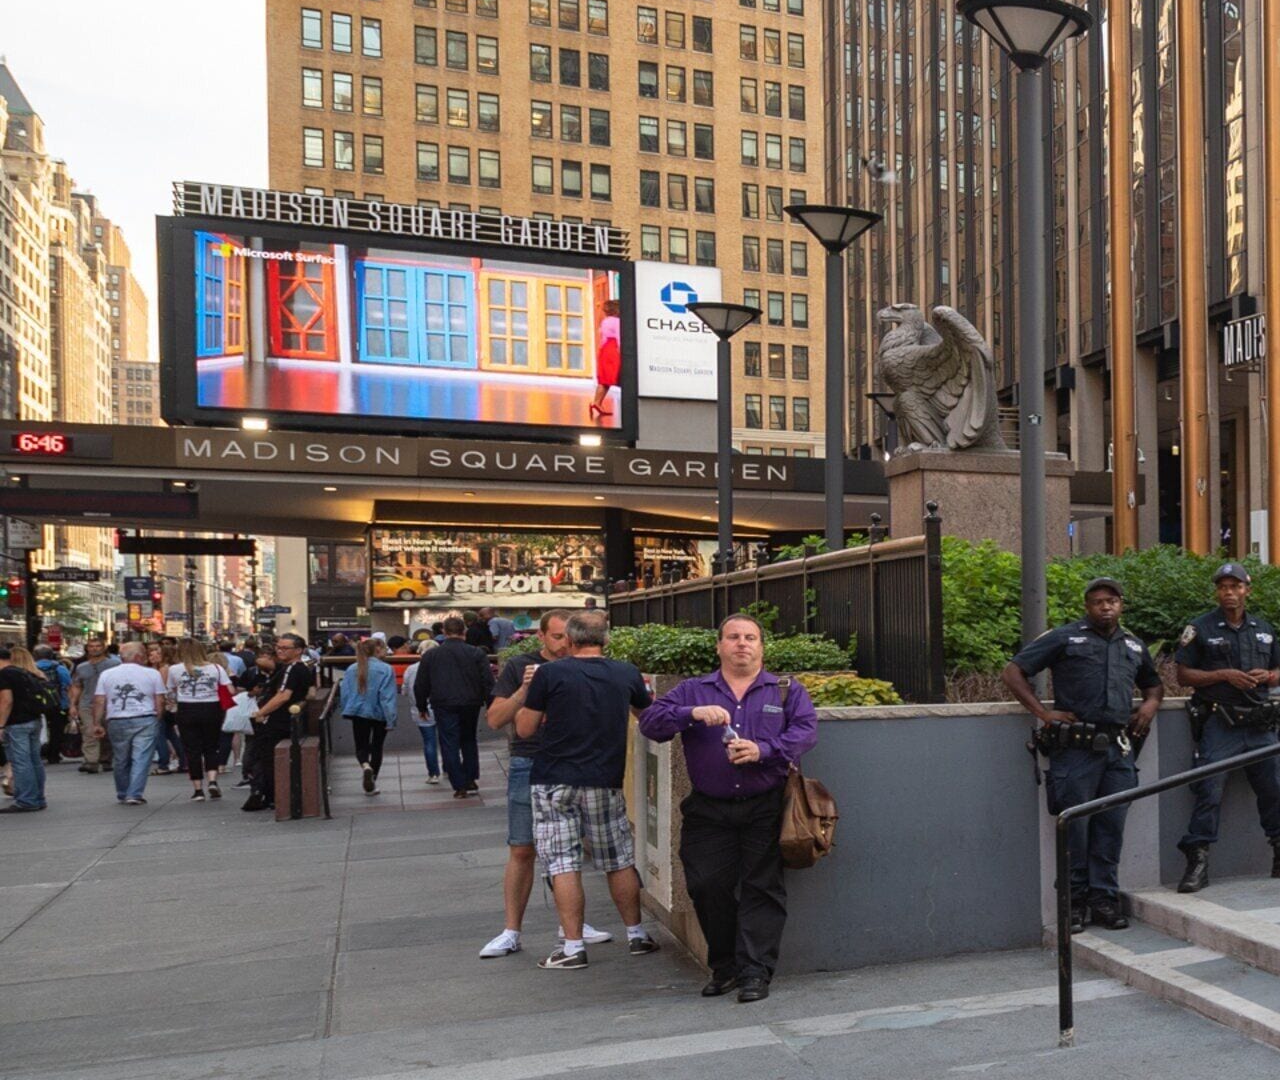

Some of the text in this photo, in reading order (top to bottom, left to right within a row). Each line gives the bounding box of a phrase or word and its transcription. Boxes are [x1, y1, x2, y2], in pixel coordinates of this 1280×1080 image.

[201, 183, 609, 255] MADISON SQUARE GARDEN
[233, 246, 293, 262] Microsoft
[647, 318, 713, 334] CHASE
[1224, 316, 1266, 366] MADIS
[19, 434, 64, 453] 6:46
[184, 438, 788, 481] MADISON SQUARE GAREN
[432, 570, 552, 594] verizon
